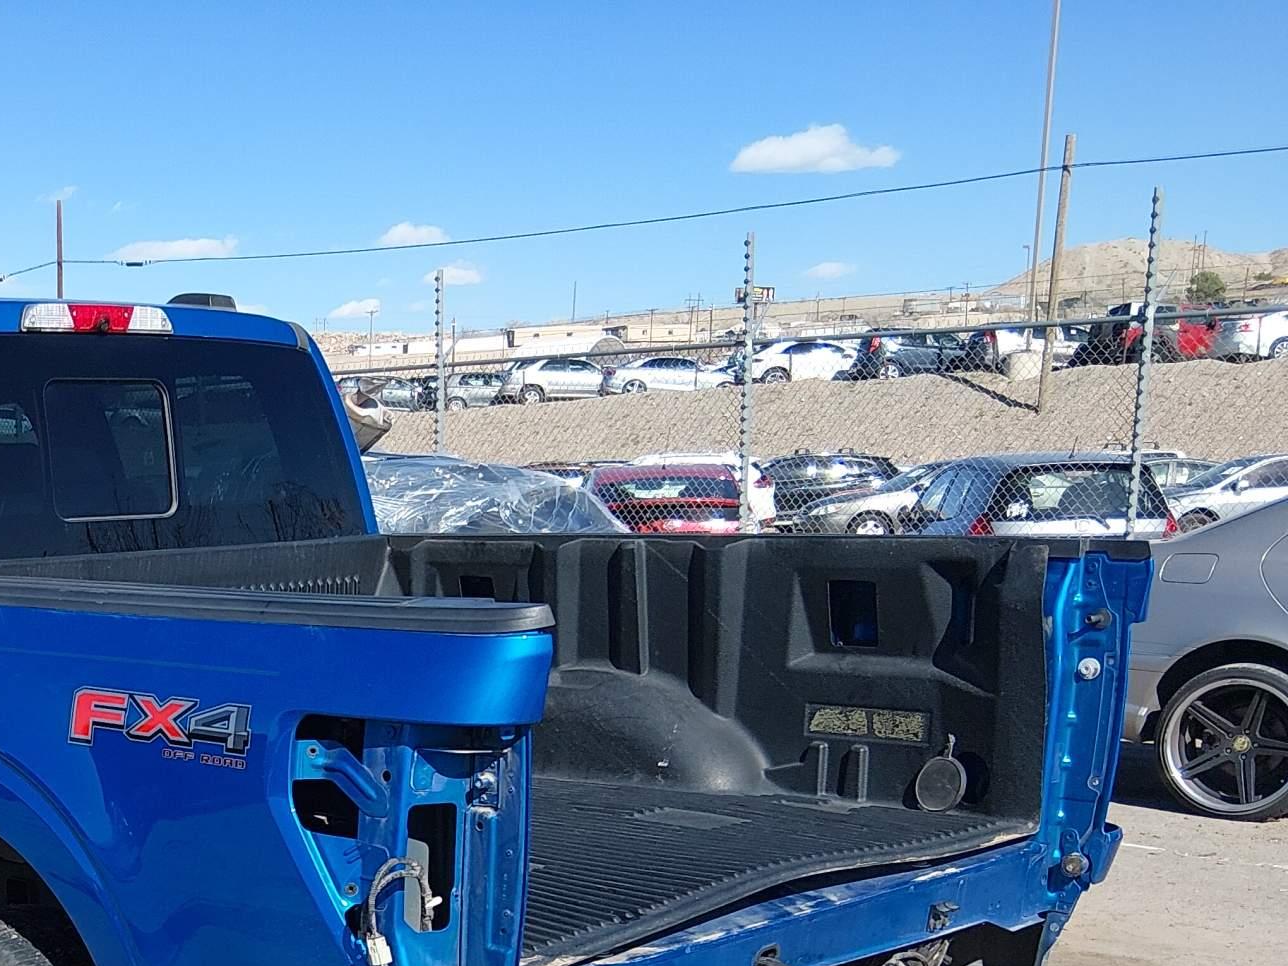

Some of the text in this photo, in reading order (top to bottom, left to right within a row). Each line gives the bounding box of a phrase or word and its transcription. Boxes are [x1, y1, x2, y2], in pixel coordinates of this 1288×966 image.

[68, 686, 252, 756] FX4
[162, 749, 247, 770] OFF ROAD
